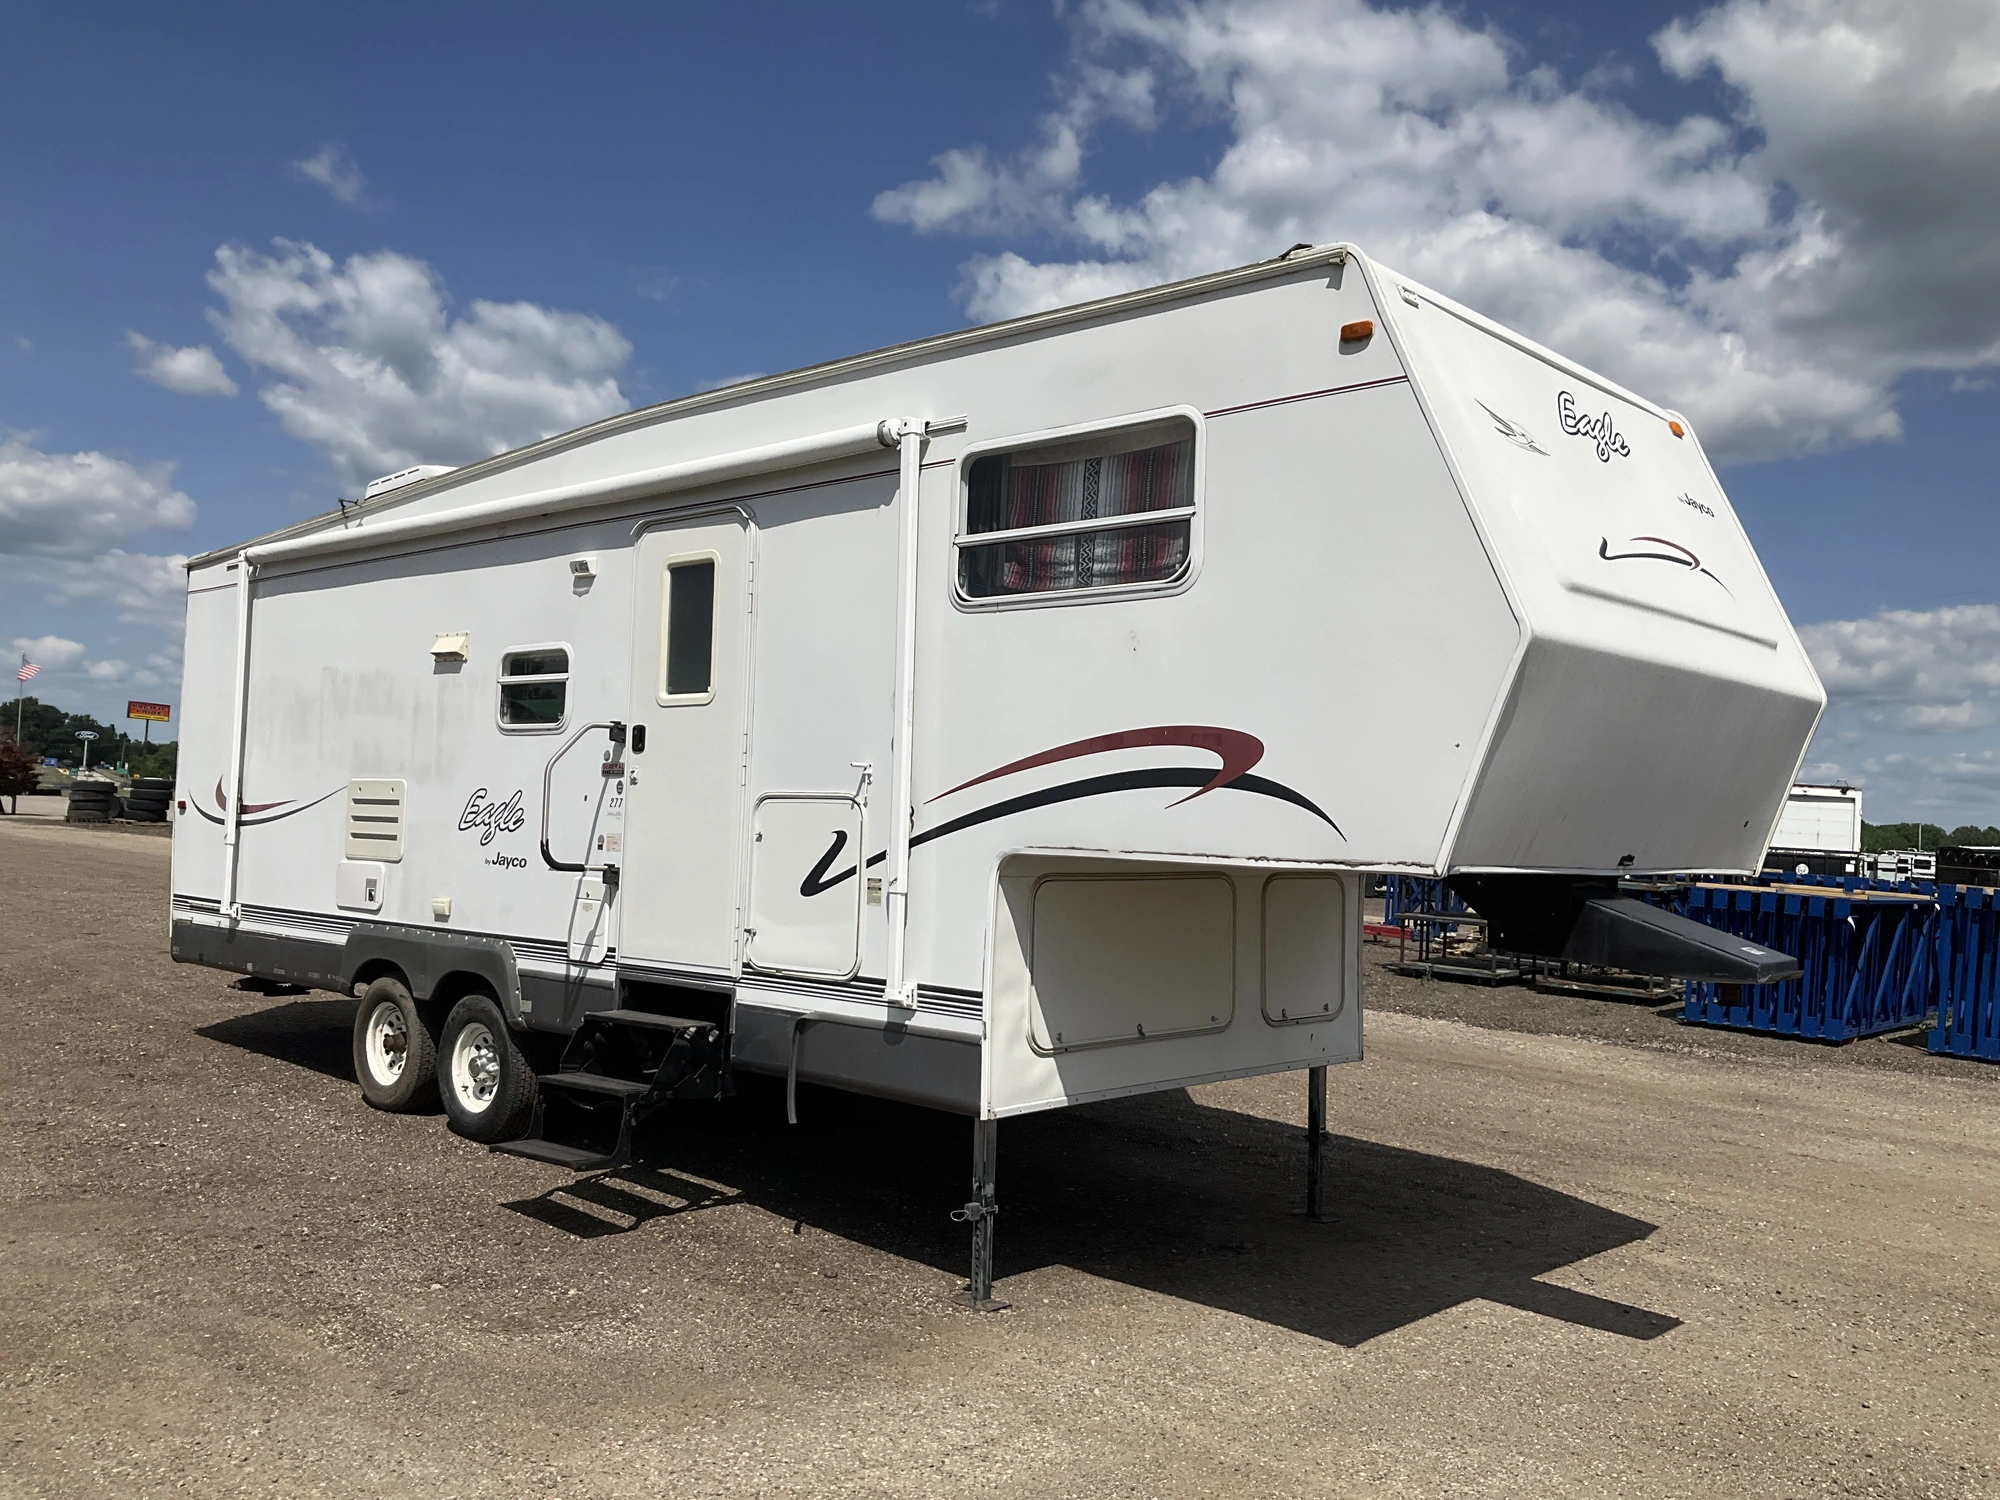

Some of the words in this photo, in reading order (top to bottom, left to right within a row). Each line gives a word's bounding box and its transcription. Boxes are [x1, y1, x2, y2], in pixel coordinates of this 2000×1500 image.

[1557, 390, 1631, 463] Eagle
[1684, 492, 1715, 518] Jayco
[609, 797, 623, 808] 277
[458, 788, 525, 846] Eagle
[484, 858, 491, 866] by
[492, 851, 527, 870] Jayco
